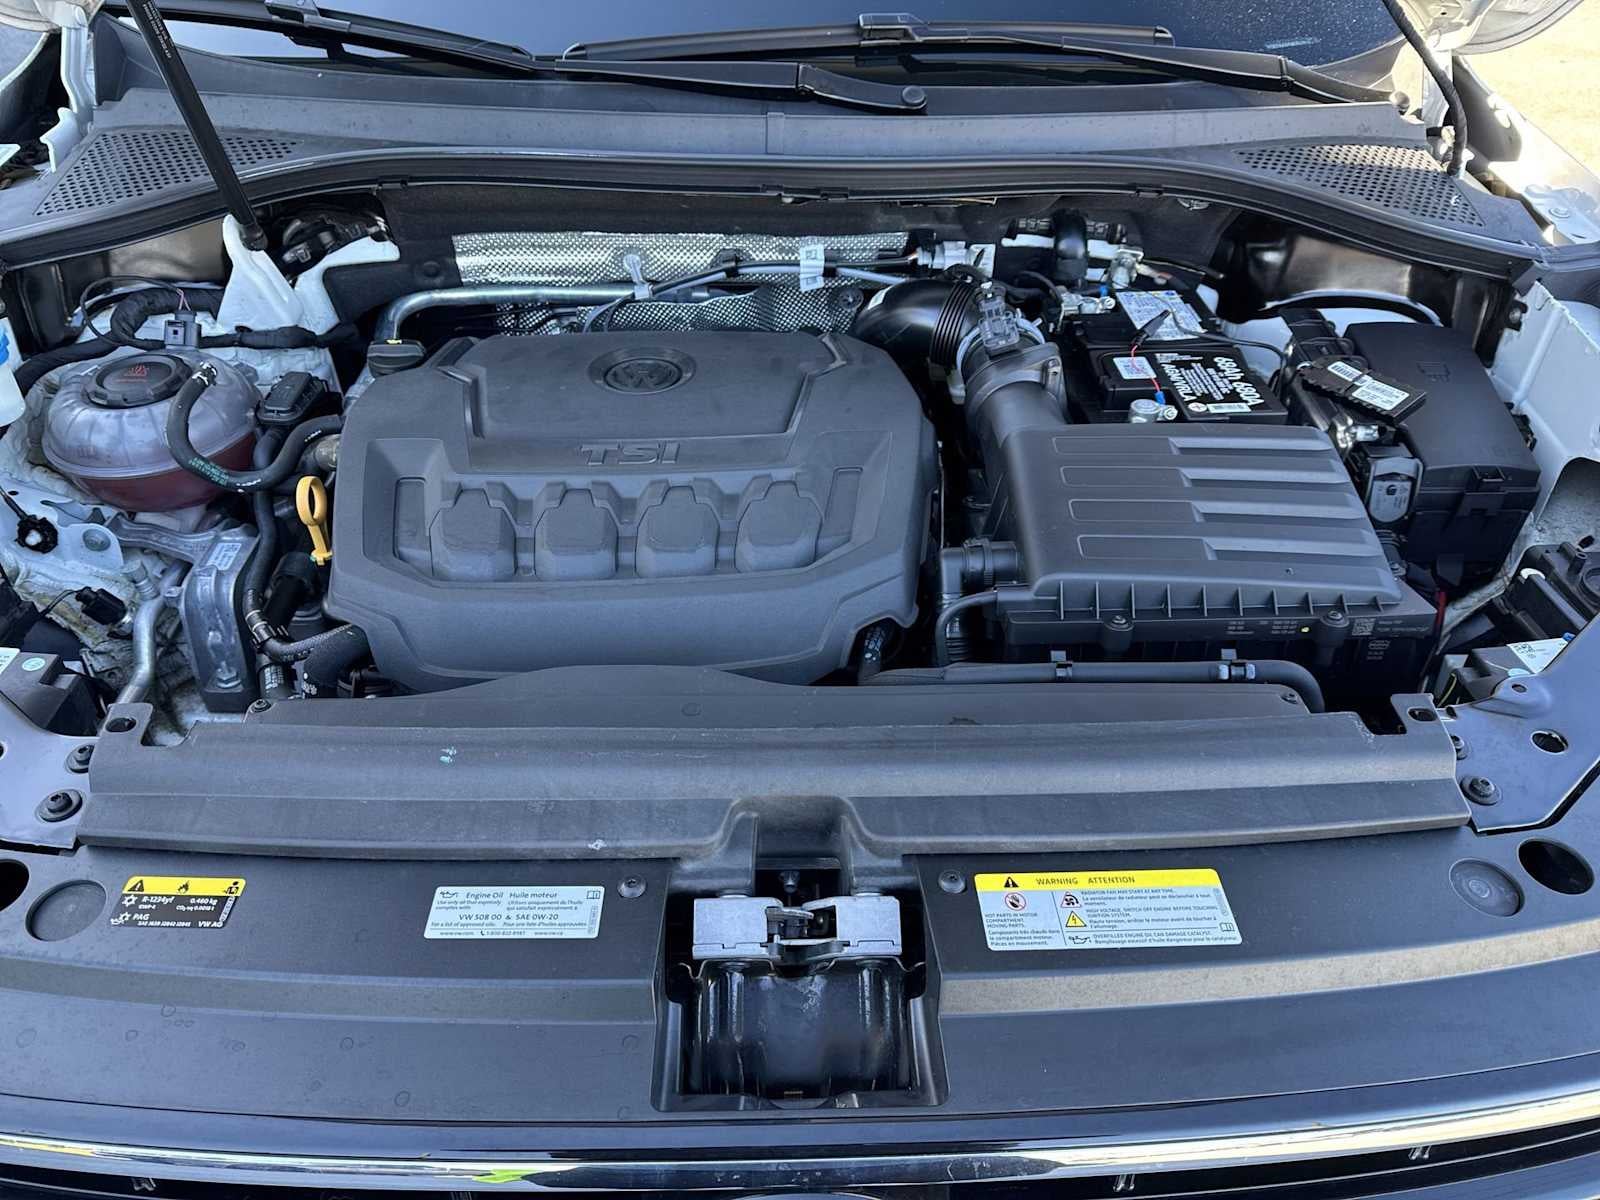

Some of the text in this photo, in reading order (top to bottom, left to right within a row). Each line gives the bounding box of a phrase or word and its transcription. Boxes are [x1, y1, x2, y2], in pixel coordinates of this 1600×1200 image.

[1213, 356, 1245, 380] 68Ah
[1232, 381, 1265, 406] 680A
[579, 441, 681, 465] TSI
[1036, 876, 1135, 886] WARNING ATTENTION
[466, 892, 491, 900] Engine
[509, 891, 558, 899] Huile moteur
[142, 895, 175, 904] R-1234yf
[209, 898, 218, 906] kg
[132, 913, 150, 921] PAG
